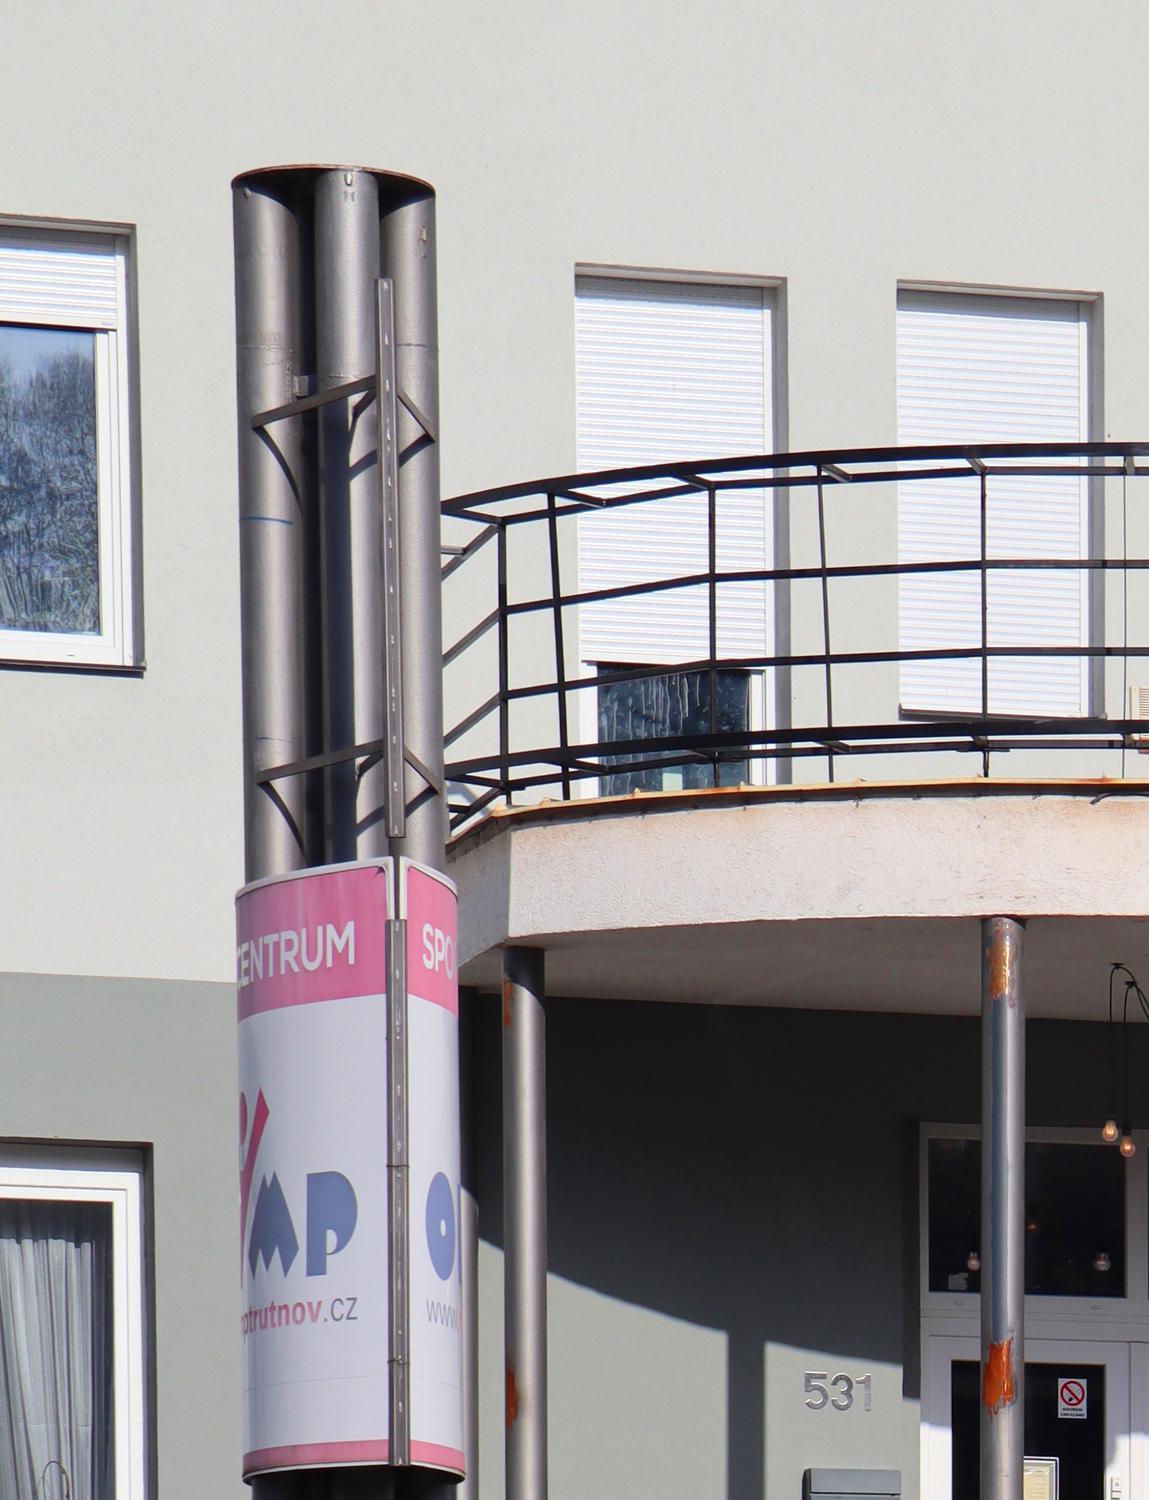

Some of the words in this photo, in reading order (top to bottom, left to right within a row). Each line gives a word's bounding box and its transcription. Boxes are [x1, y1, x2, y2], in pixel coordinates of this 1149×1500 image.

[422, 923, 458, 979] SPO
[425, 1171, 462, 1285] O
[241, 1297, 358, 1344] ptrutnov.cz
[804, 1371, 872, 1411] 531
